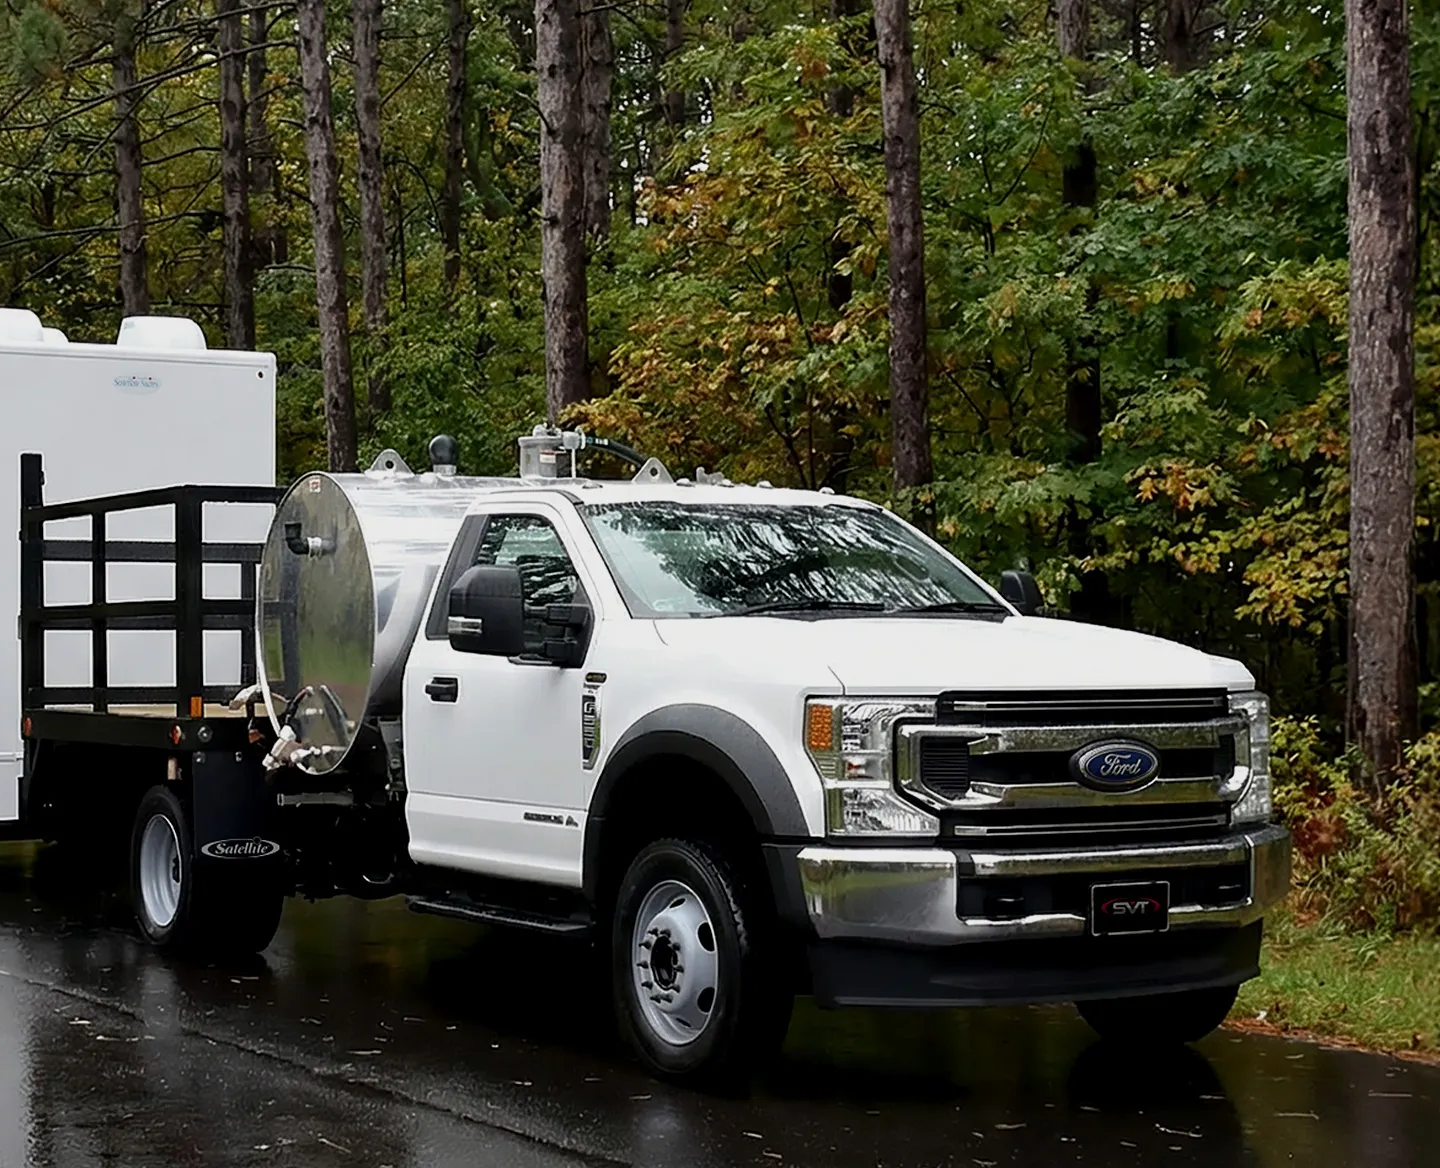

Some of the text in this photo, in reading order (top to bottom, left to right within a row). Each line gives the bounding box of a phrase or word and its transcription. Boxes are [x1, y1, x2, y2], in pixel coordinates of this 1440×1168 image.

[1100, 753, 1142, 776] Ford
[215, 842, 268, 855] Satellite
[1112, 901, 1150, 915] SVT
